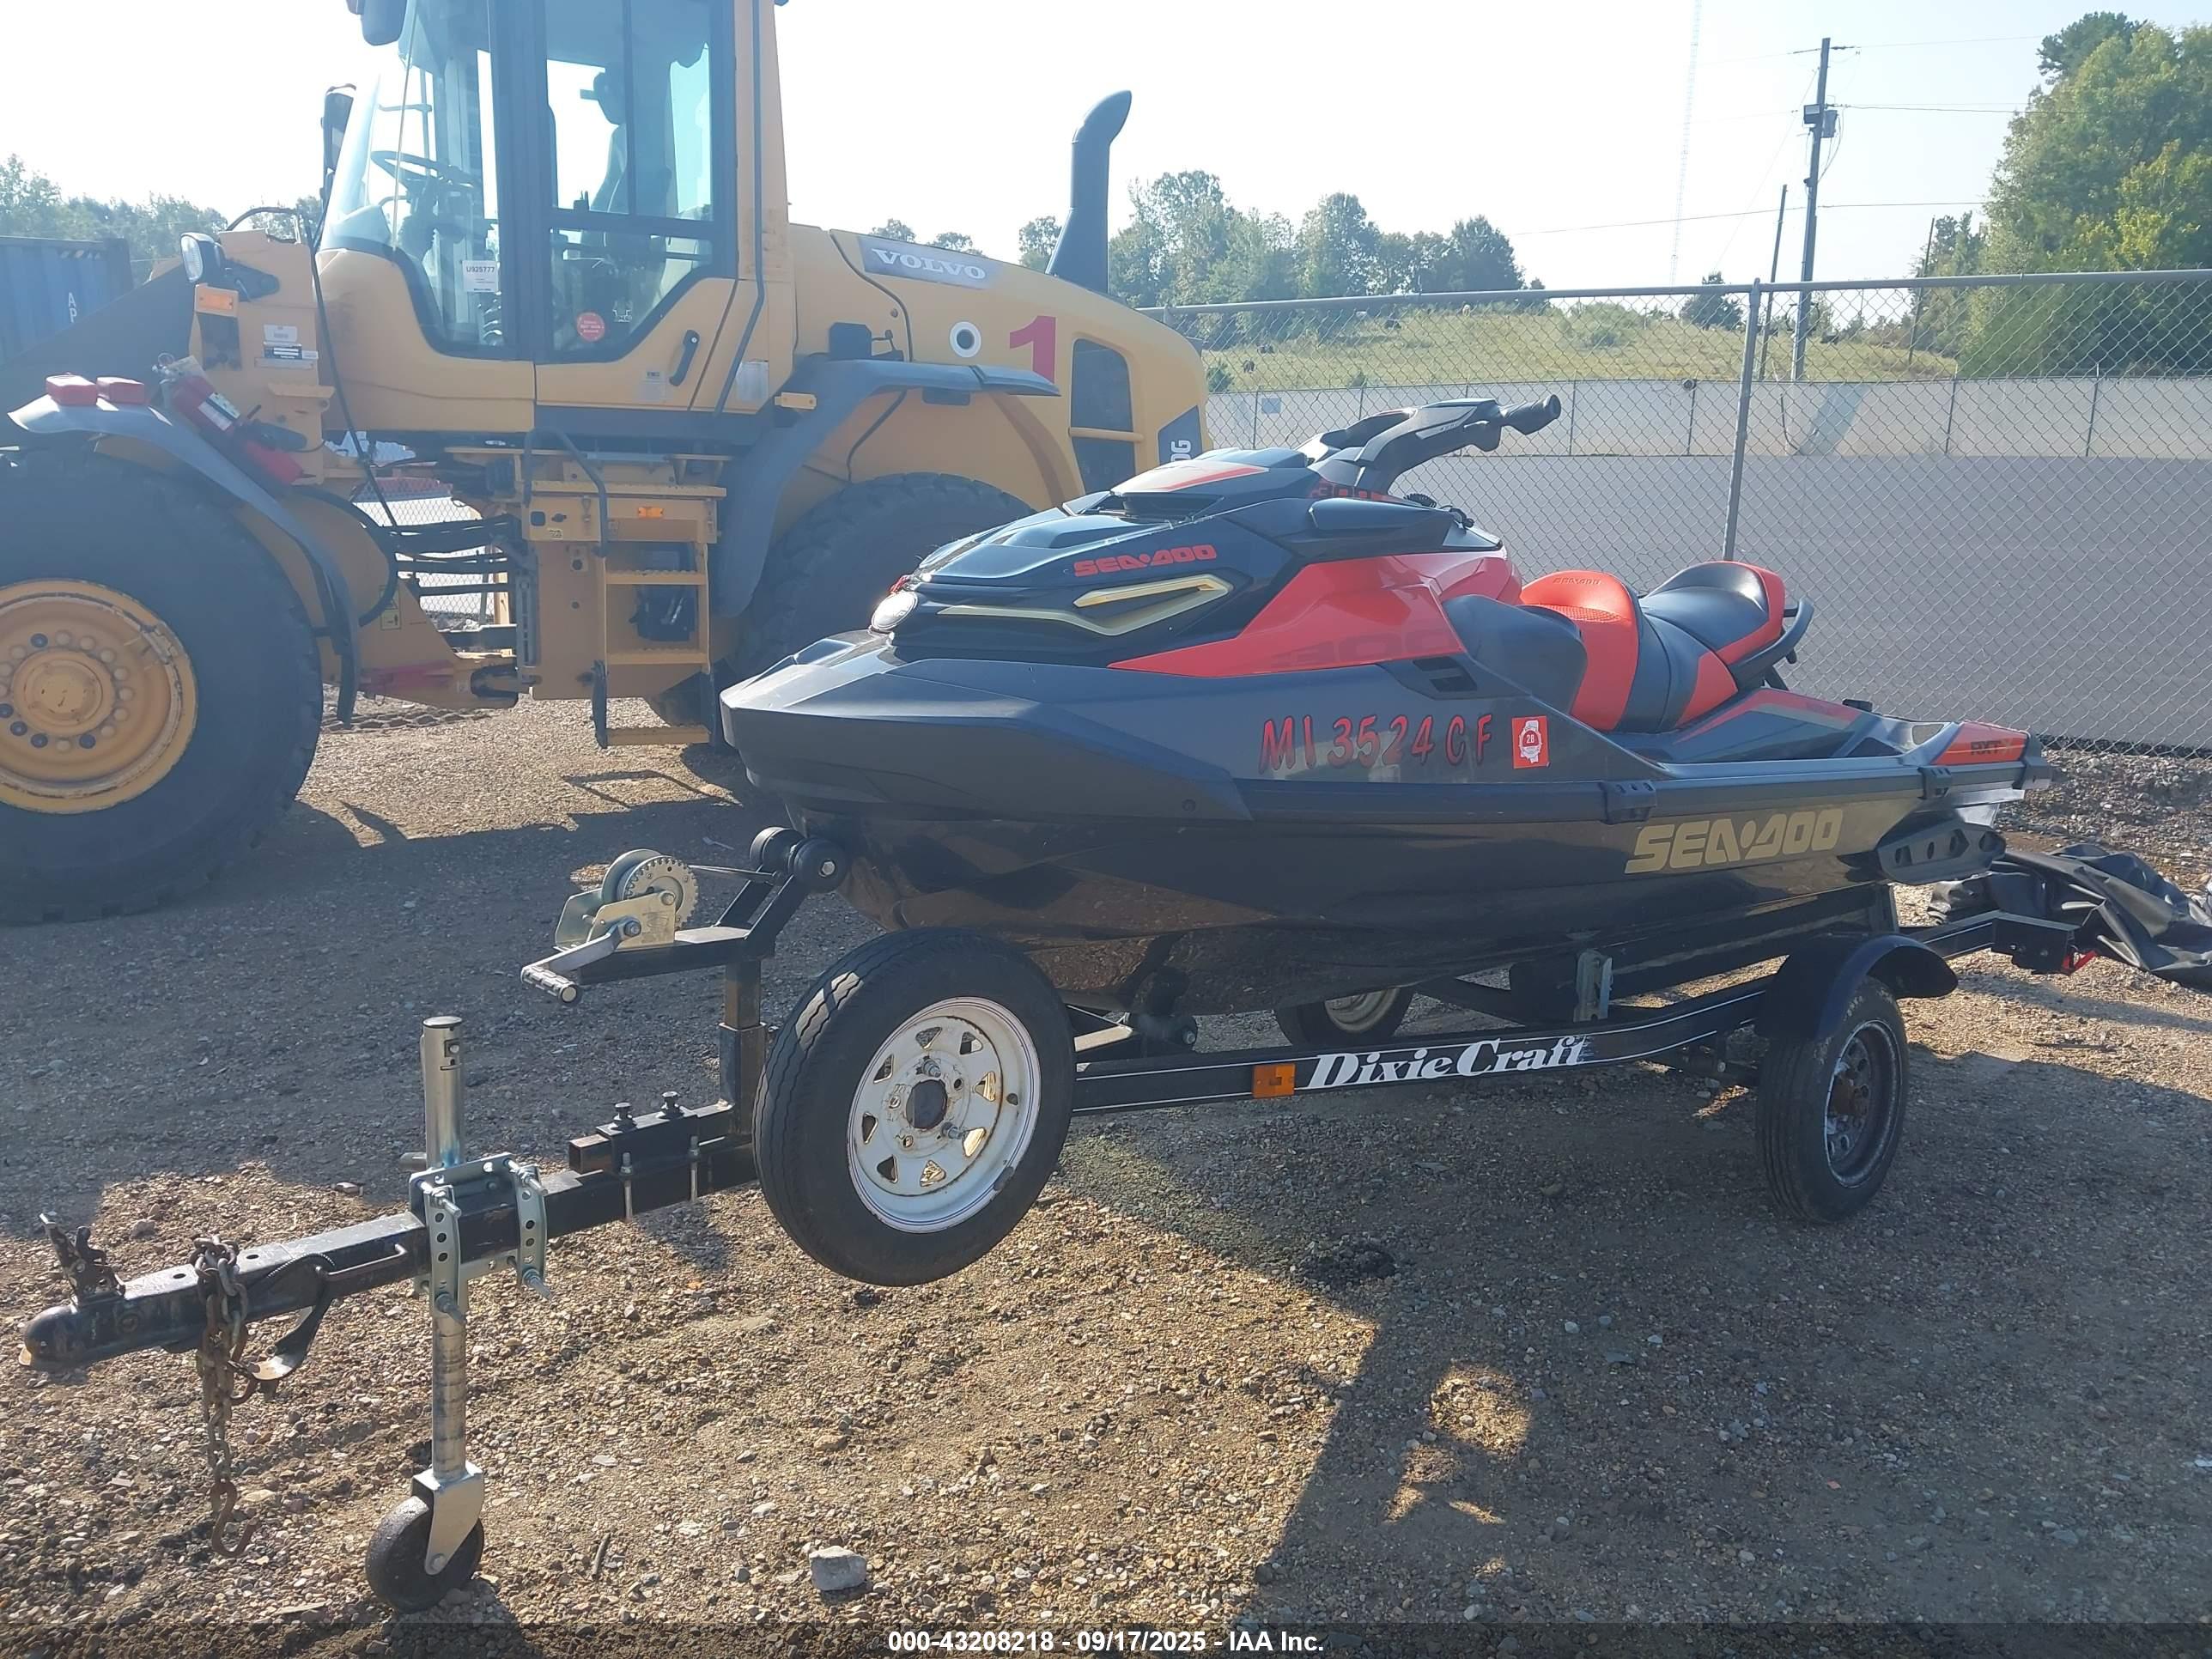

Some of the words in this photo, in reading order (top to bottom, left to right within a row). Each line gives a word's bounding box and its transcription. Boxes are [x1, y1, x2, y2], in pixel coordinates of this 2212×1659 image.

[872, 248, 986, 279] VOLVO
[1009, 315, 1056, 384] 1
[1258, 714, 1318, 775] MI
[1327, 714, 1436, 769] 3524
